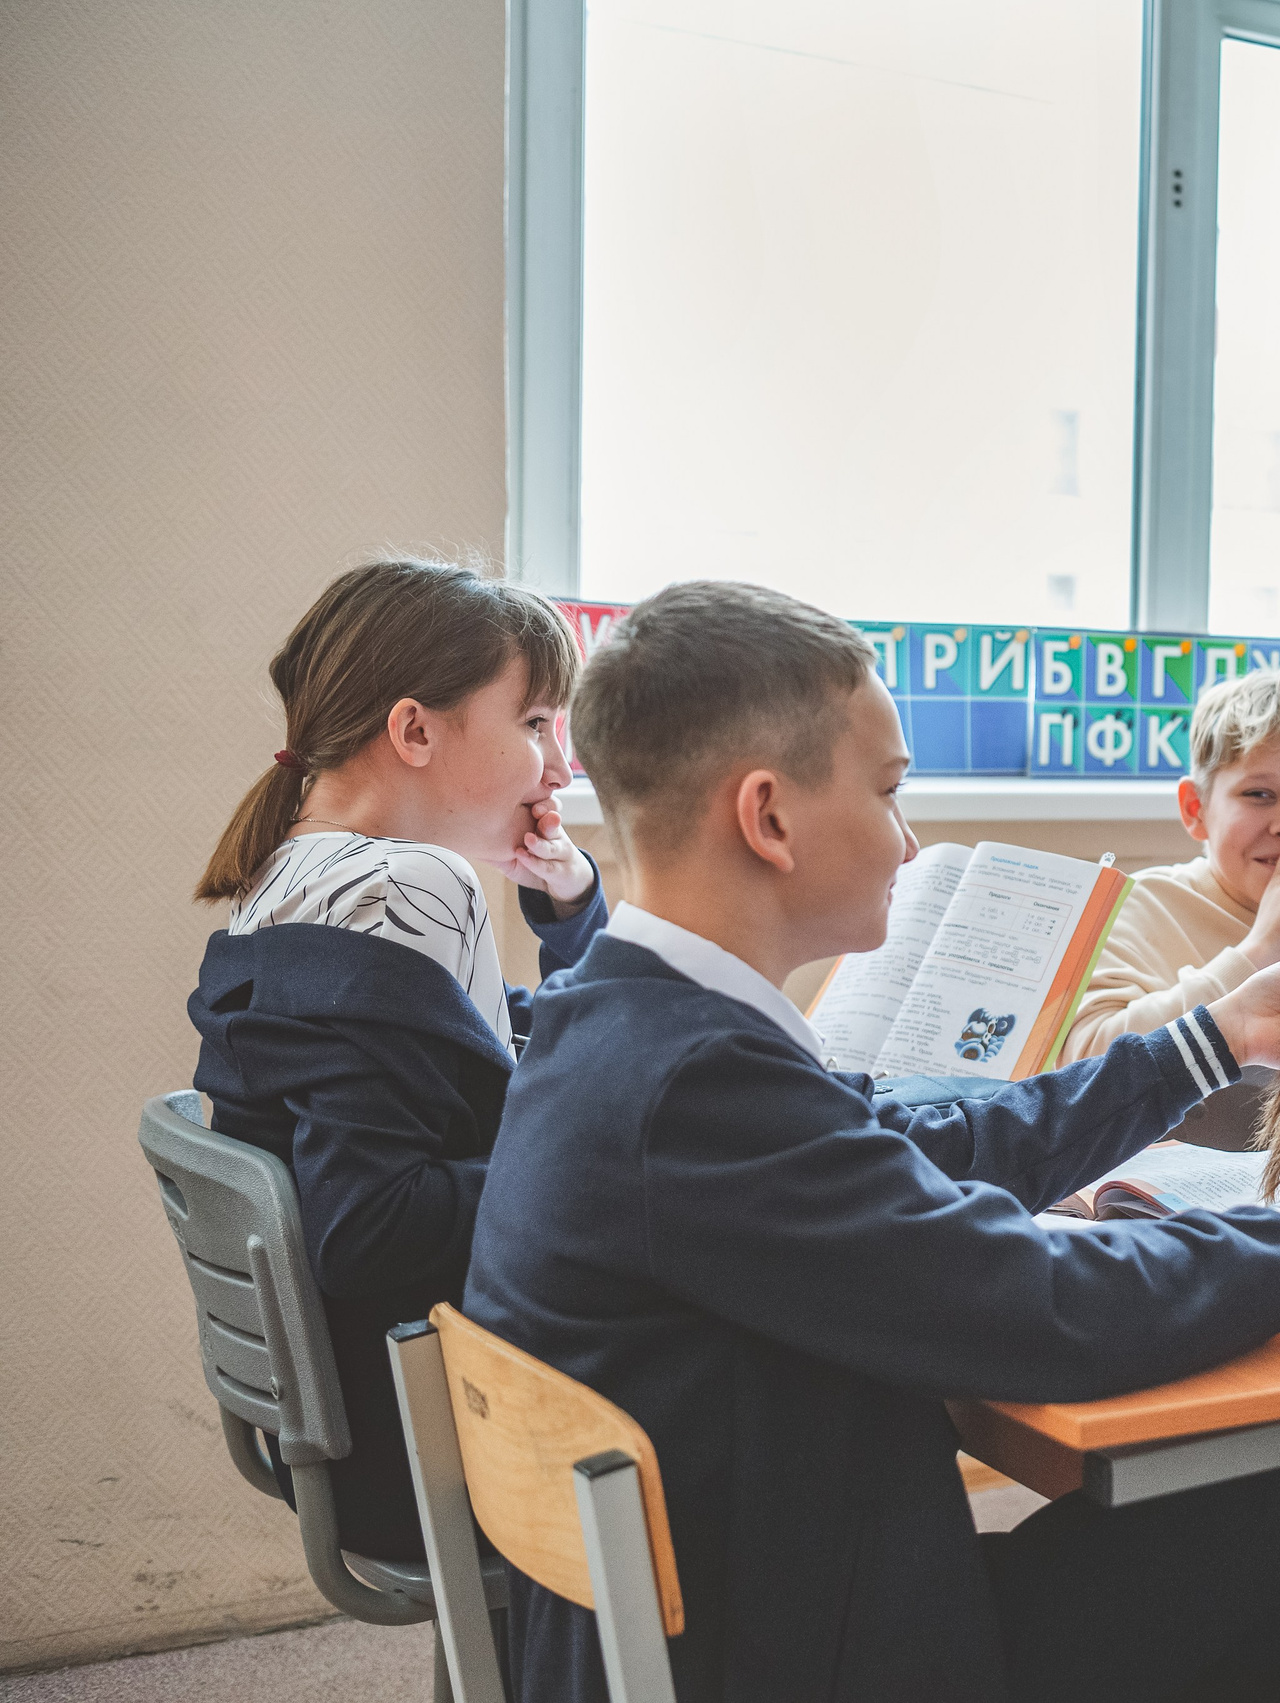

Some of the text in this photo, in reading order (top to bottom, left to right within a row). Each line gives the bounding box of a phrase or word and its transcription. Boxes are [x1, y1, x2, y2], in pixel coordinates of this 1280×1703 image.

[924, 633, 958, 690] Р
[1042, 640, 1073, 694] Б
[1096, 643, 1127, 697] В
[1087, 714, 1133, 767] Ф
[1147, 715, 1184, 768] К
